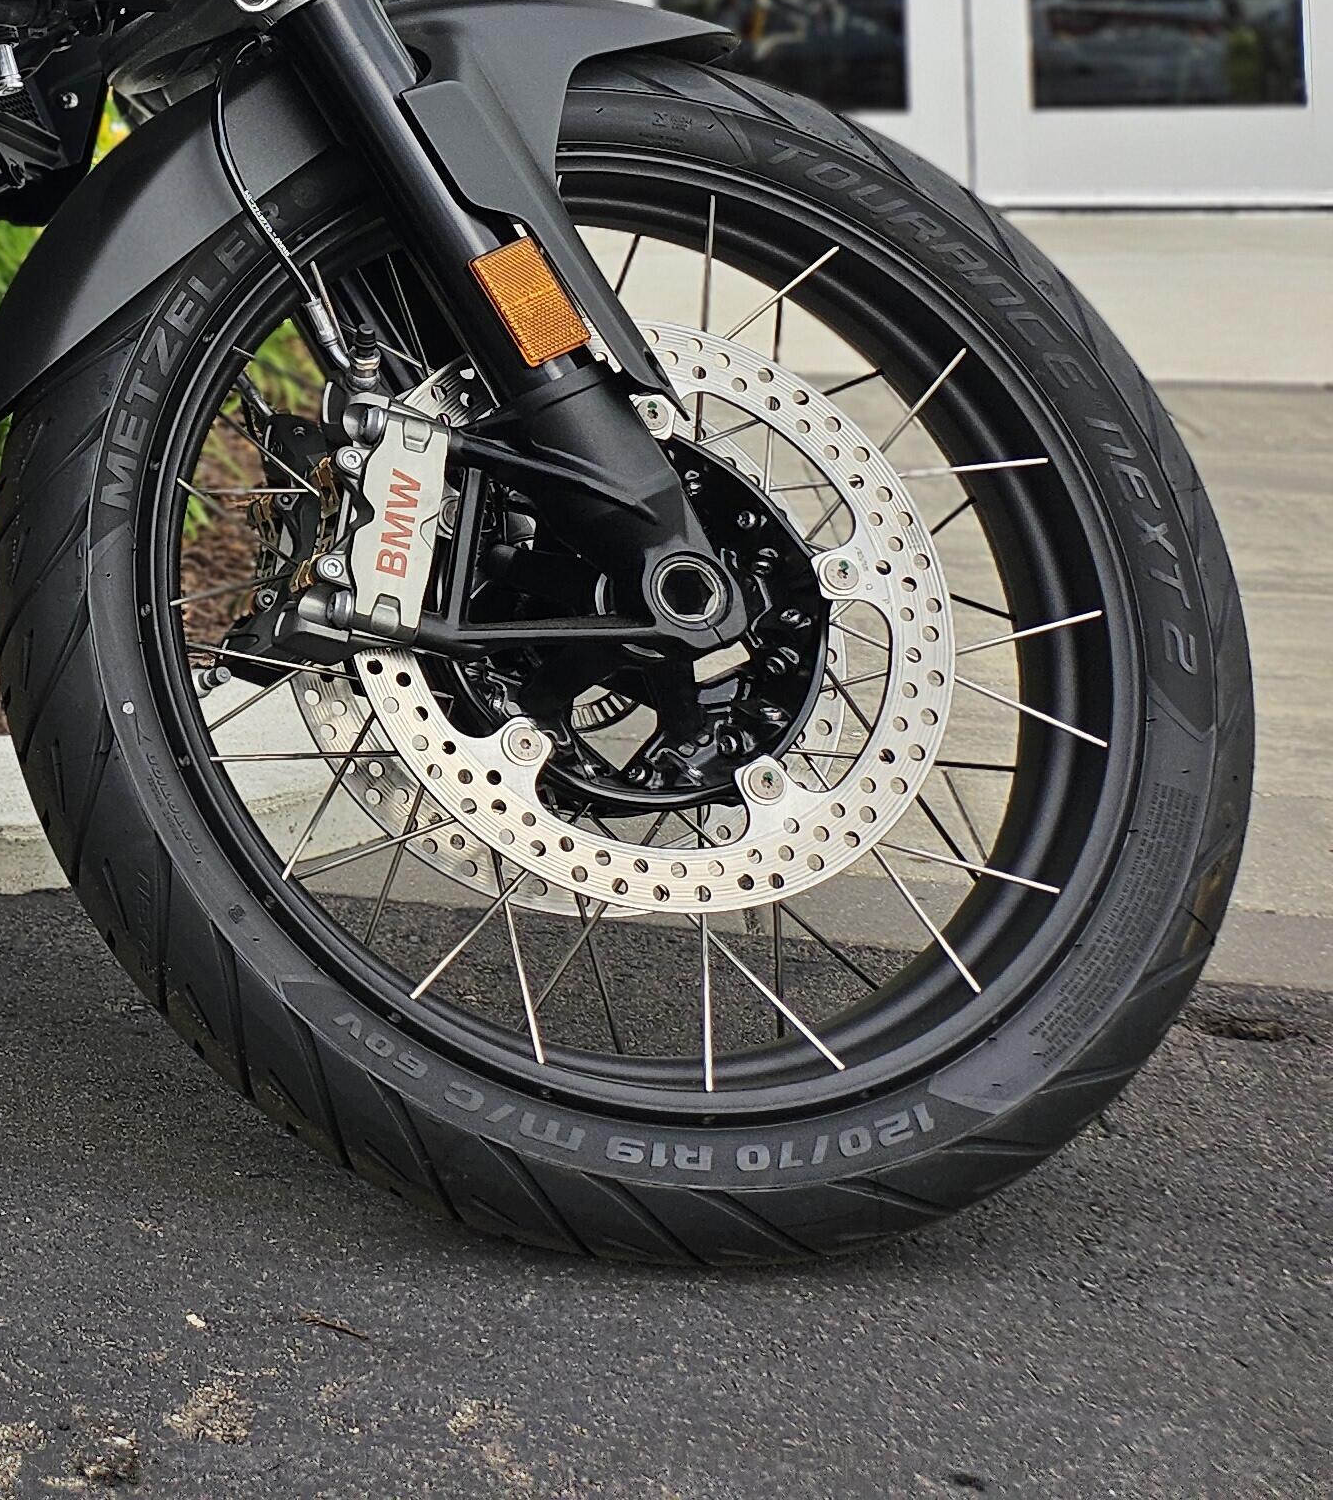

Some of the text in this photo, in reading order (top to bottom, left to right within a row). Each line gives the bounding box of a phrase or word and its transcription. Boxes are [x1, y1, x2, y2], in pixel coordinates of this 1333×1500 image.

[99, 202, 286, 511] METZELER
[375, 468, 423, 579] BMW
[1161, 628, 1199, 675] 2
[332, 1011, 936, 1172] 120/70 R19 M/C 60V
